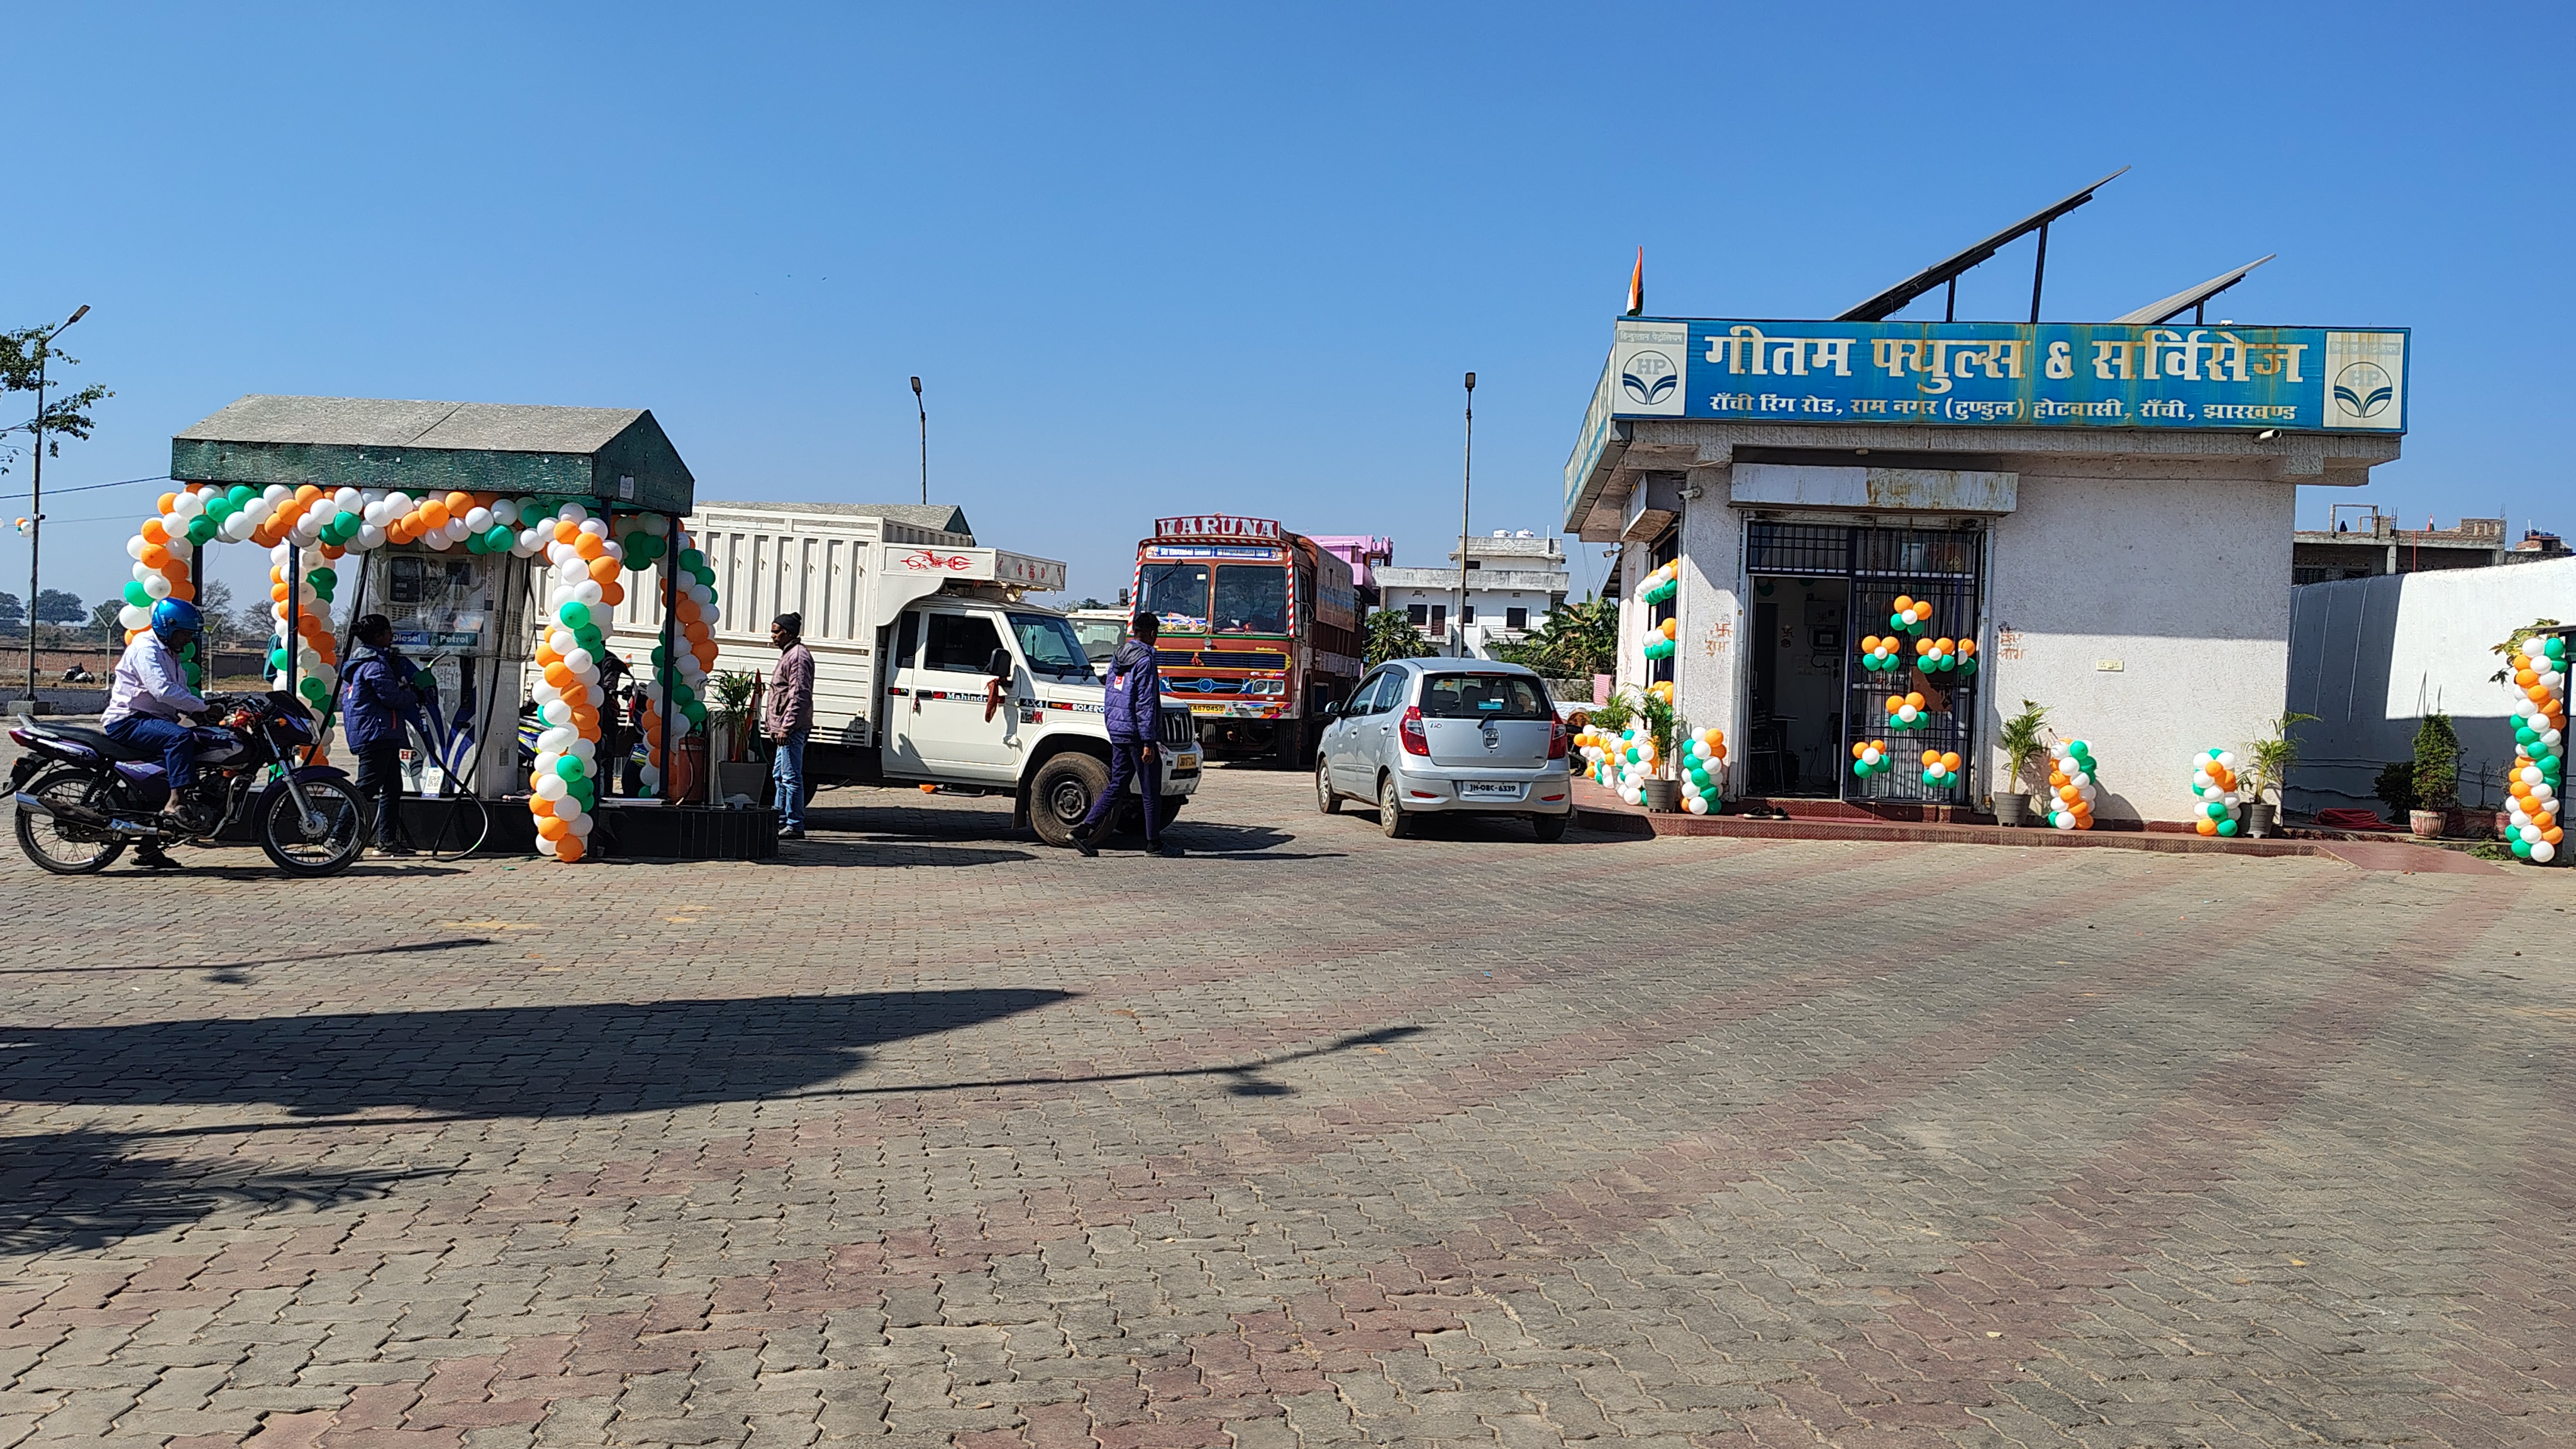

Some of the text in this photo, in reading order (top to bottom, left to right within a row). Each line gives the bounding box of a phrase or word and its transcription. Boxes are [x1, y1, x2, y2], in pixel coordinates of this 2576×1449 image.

[1704, 325, 2308, 394] गीतम फ्युल्स & सर्विसेज
[1636, 358, 1667, 375] HP
[2348, 370, 2381, 387] HP
[1759, 394, 1797, 411] रिंग
[1801, 395, 1843, 416] रोड,
[1850, 399, 1888, 414] राम
[1893, 401, 1939, 414] नगर
[2033, 398, 2132, 420] होटवासी,
[2202, 404, 2297, 419] झारखण्ड
[392, 634, 469, 643] Diesel Petrol
[947, 692, 989, 702] Mahindr
[1072, 703, 1105, 713] BOLERO
[401, 751, 418, 760] HP
